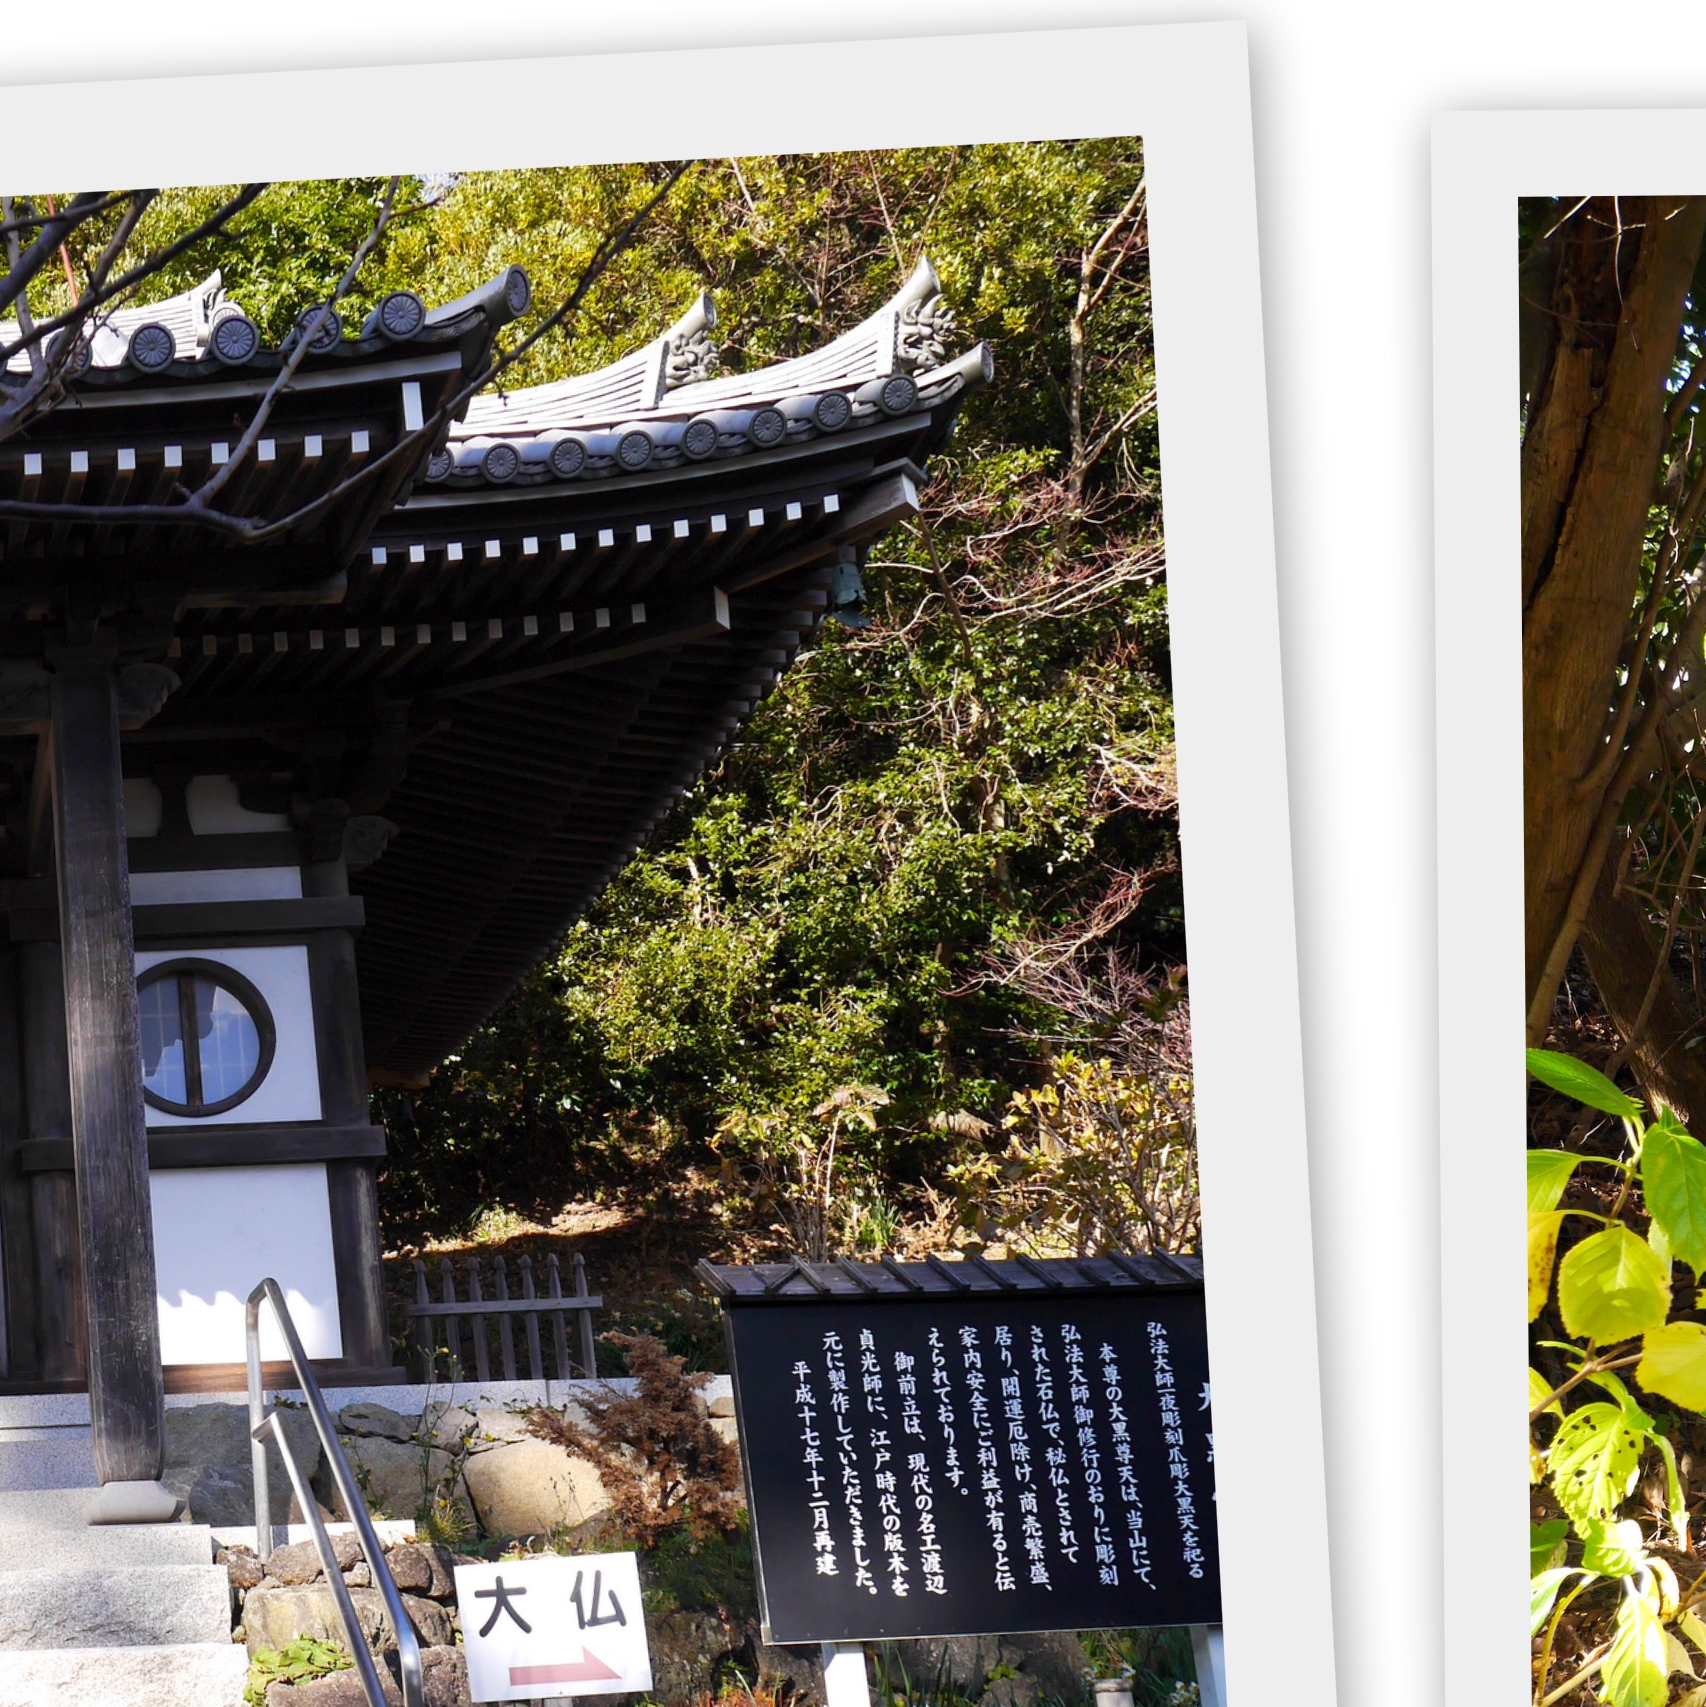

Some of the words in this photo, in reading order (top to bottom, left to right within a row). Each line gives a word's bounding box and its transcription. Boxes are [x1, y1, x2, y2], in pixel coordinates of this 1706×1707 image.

[791, 1361, 840, 1576] 平成十七年十二月再建
[822, 1331, 878, 1596] 元に製作していただきました。
[927, 1327, 969, 1496] えられております。
[958, 1325, 1017, 1591] 家内安全にご利益が有ると伝
[994, 1325, 1053, 1592] 居り、開運厄除け、商売繁盛、
[1029, 1324, 1080, 1564] された石仏で、秘仏とされて
[1060, 1323, 1120, 1587] 弘法大師御修行のおりに彫刻
[1098, 1342, 1157, 1591] 本尊の大黒尊天は、当山にて、
[474, 1568, 627, 1638] 大仏
